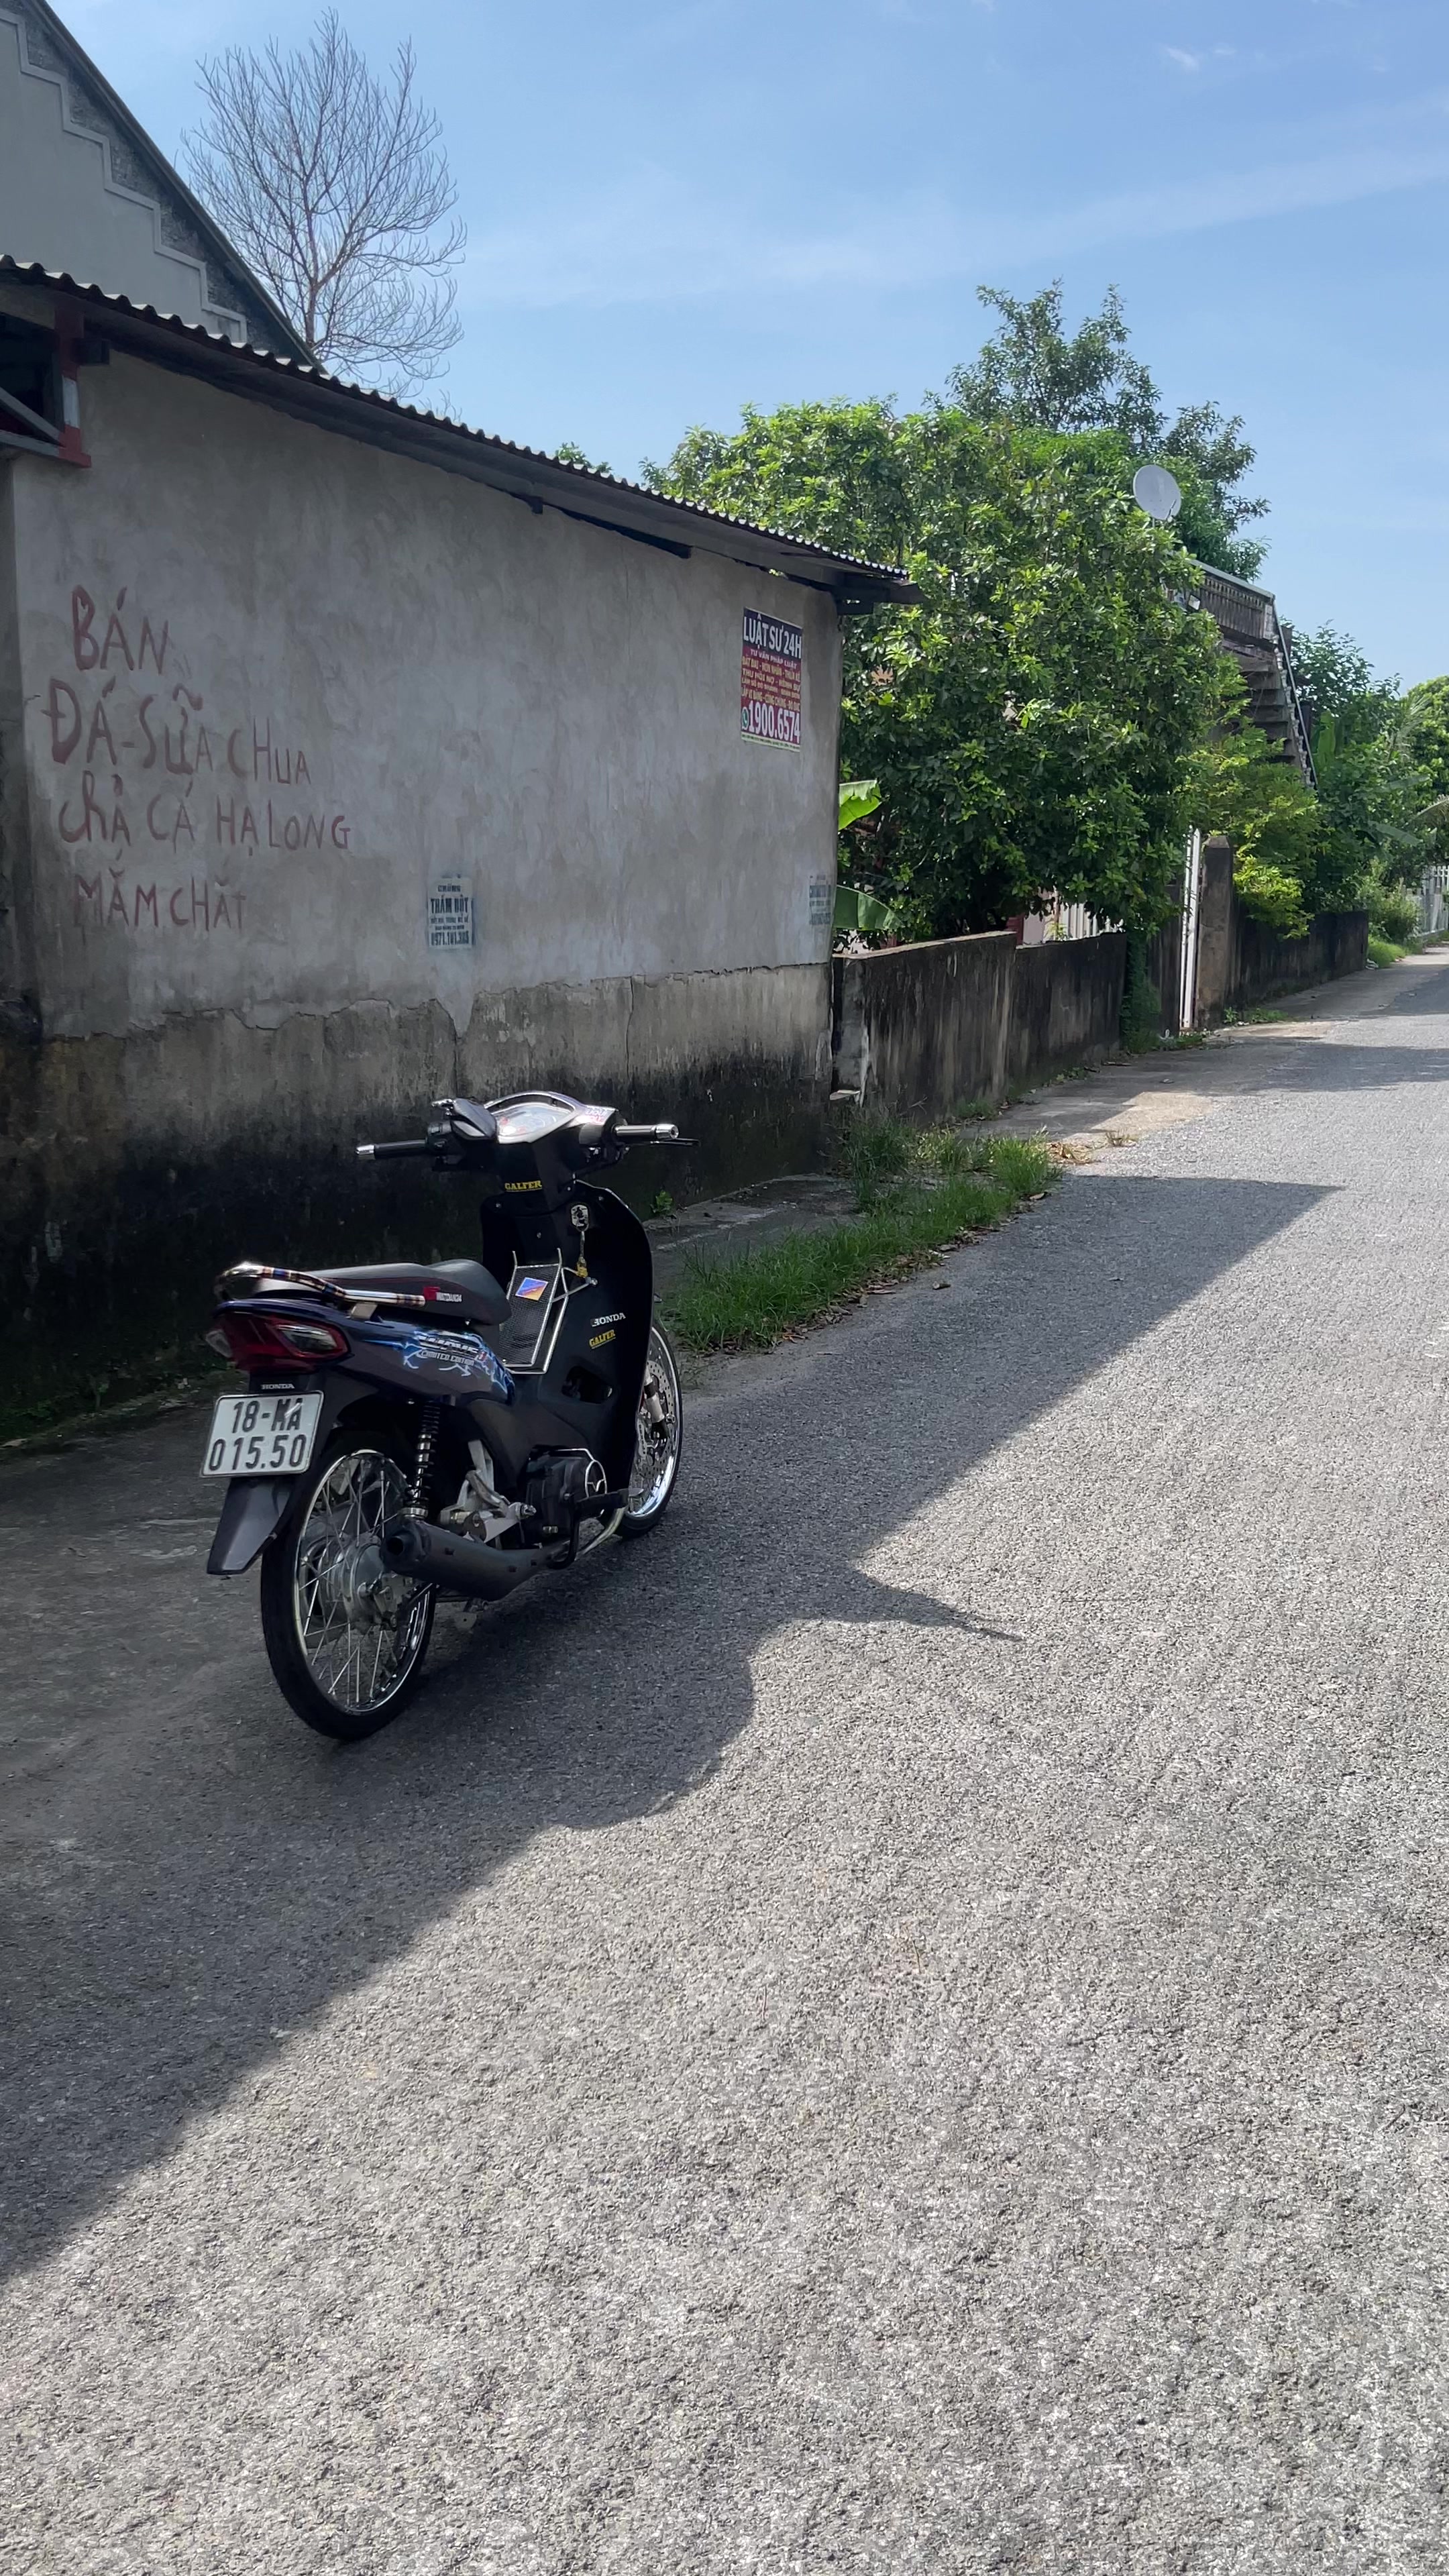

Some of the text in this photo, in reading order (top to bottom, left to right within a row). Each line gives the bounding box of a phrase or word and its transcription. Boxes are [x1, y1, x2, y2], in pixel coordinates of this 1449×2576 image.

[72, 584, 169, 675] BÁN
[743, 613, 802, 659] LUẬT SƯ 24H
[749, 699, 800, 745] 1900.6574
[227, 718, 311, 785] CHUA
[147, 781, 195, 854] CÁ
[216, 794, 259, 857] HẠ
[268, 799, 352, 851] LONG
[504, 1180, 542, 1191] GALFER
[209, 1434, 307, 1471] 015.50
